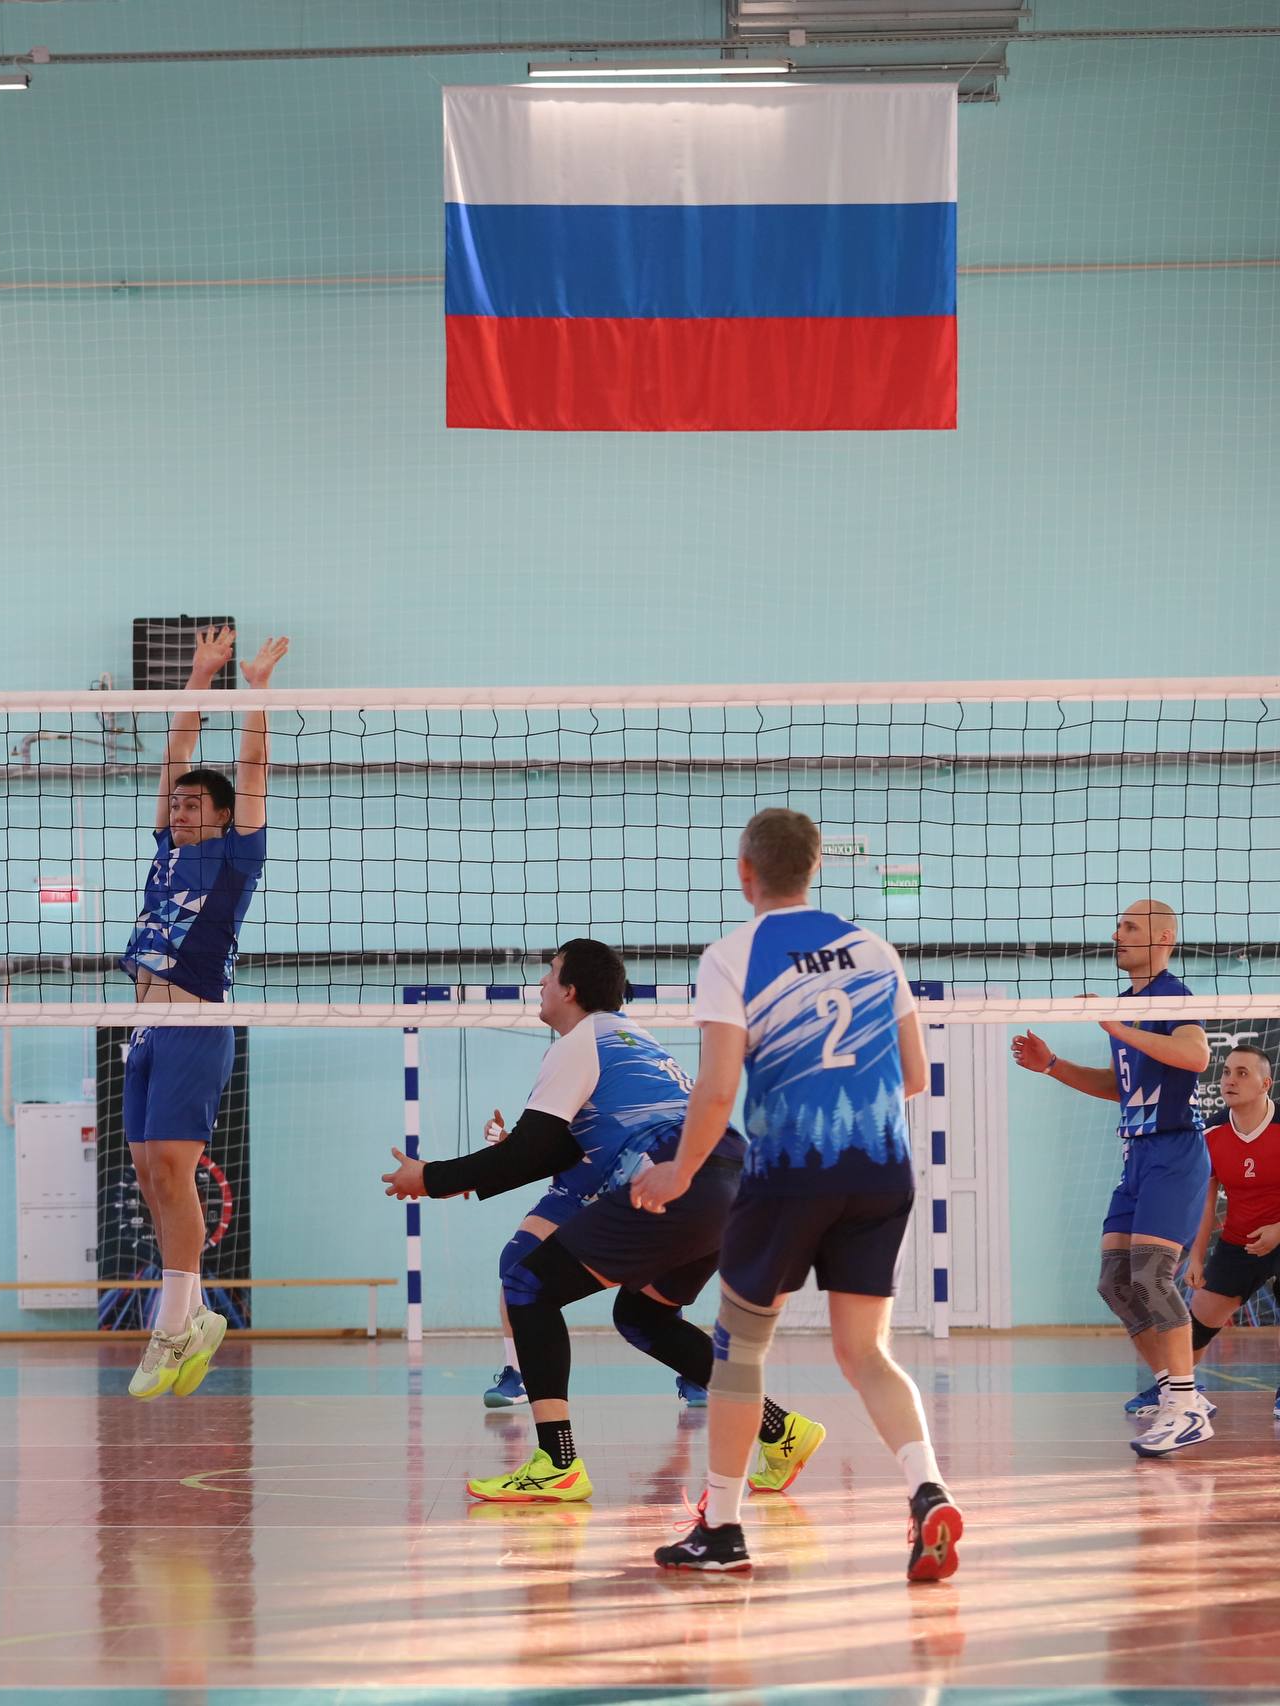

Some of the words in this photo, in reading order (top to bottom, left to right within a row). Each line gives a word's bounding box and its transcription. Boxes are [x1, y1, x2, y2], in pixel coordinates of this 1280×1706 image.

[786, 947, 857, 975] ТАРА
[815, 987, 857, 1069] 2
[1118, 1048, 1131, 1093] 5
[1243, 1158, 1256, 1178] 2
